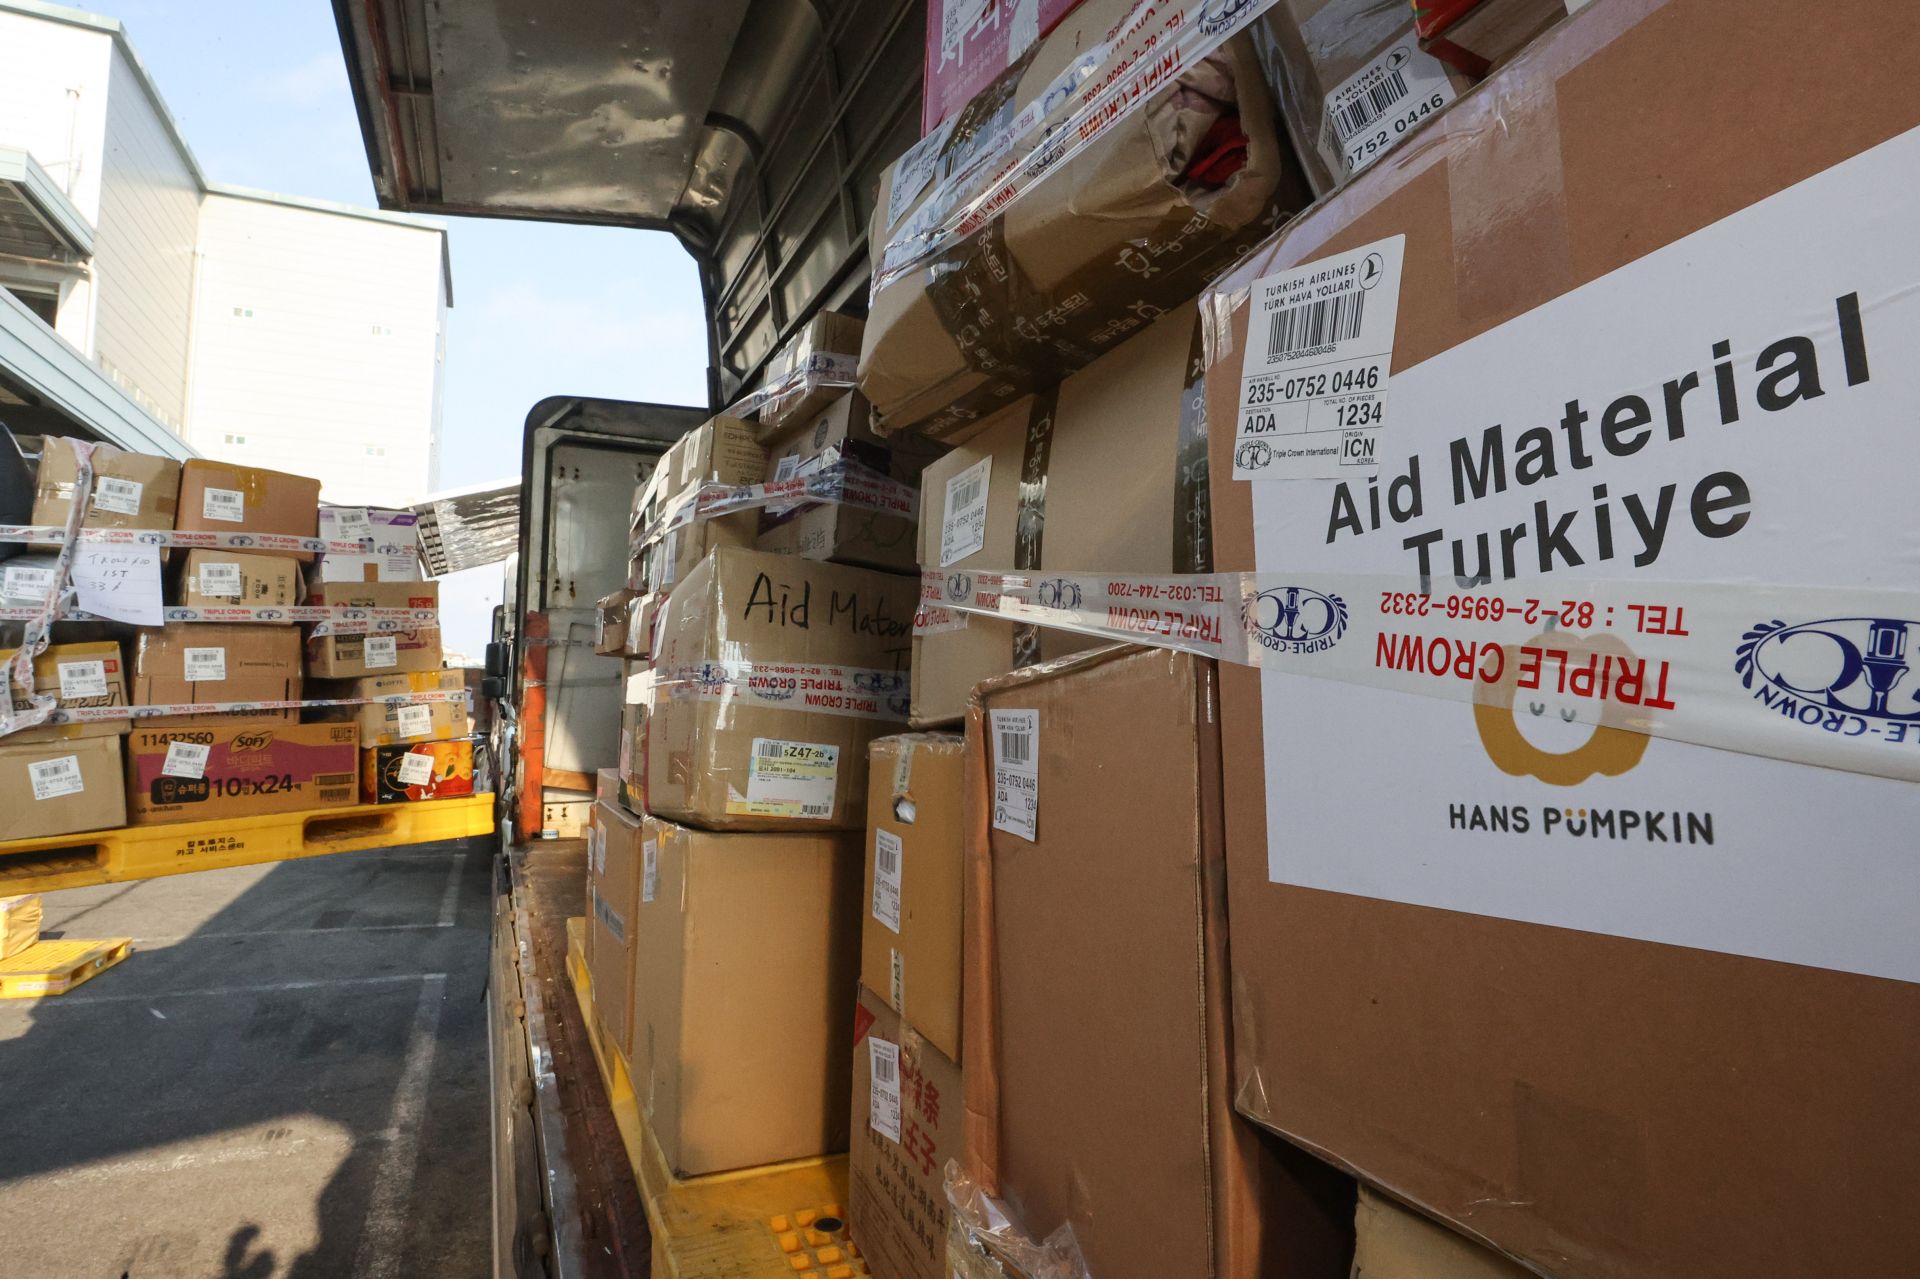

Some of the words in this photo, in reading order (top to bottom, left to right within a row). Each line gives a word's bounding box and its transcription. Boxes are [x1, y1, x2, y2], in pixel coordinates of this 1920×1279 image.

[1335, 64, 1382, 103] AIRLINES
[1346, 72, 1385, 103] YOLLARI
[1347, 131, 1389, 169] 0752
[1395, 93, 1444, 134] 0446
[1266, 278, 1305, 298] TURKISH
[1309, 263, 1356, 285] AIRLINES
[1288, 291, 1313, 305] HAVA
[1316, 279, 1355, 298] YOLLARI
[1248, 373, 1326, 404] 235-0752
[1332, 365, 1379, 393] 0446
[1323, 398, 1339, 406] TOTAL
[1356, 394, 1375, 402] PIECES
[1244, 413, 1276, 434] ADA
[1336, 401, 1382, 427] 1234
[1325, 456, 1422, 544] Aid
[1450, 292, 1871, 506] Material
[1273, 450, 1287, 459] Triple
[1288, 449, 1305, 457] Crown
[1305, 446, 1339, 457] International
[1344, 438, 1375, 458] ICN
[1403, 466, 1753, 597] Turkiye
[744, 572, 810, 629] Aid
[829, 590, 912, 637] Mater
[1108, 582, 1224, 603] TEL:032-744-7200
[1106, 606, 1160, 632] CROWN
[1380, 591, 1594, 628] 82-2-6956-2332
[1627, 603, 1689, 636] TEL
[1161, 611, 1223, 644] TRIPLE
[1376, 631, 1505, 684] CROWN
[748, 676, 797, 690] CROWN
[801, 678, 843, 691] TRIPLE
[1517, 646, 1676, 710] TRIPLE
[804, 693, 842, 708] CROWN
[845, 698, 879, 712] TRIPLE
[1754, 684, 1920, 743] LE-CROWN
[141, 732, 214, 746] 11432560
[997, 772, 1021, 788] 235-0752
[997, 791, 1008, 802] ADA
[1449, 804, 1530, 834] HANS
